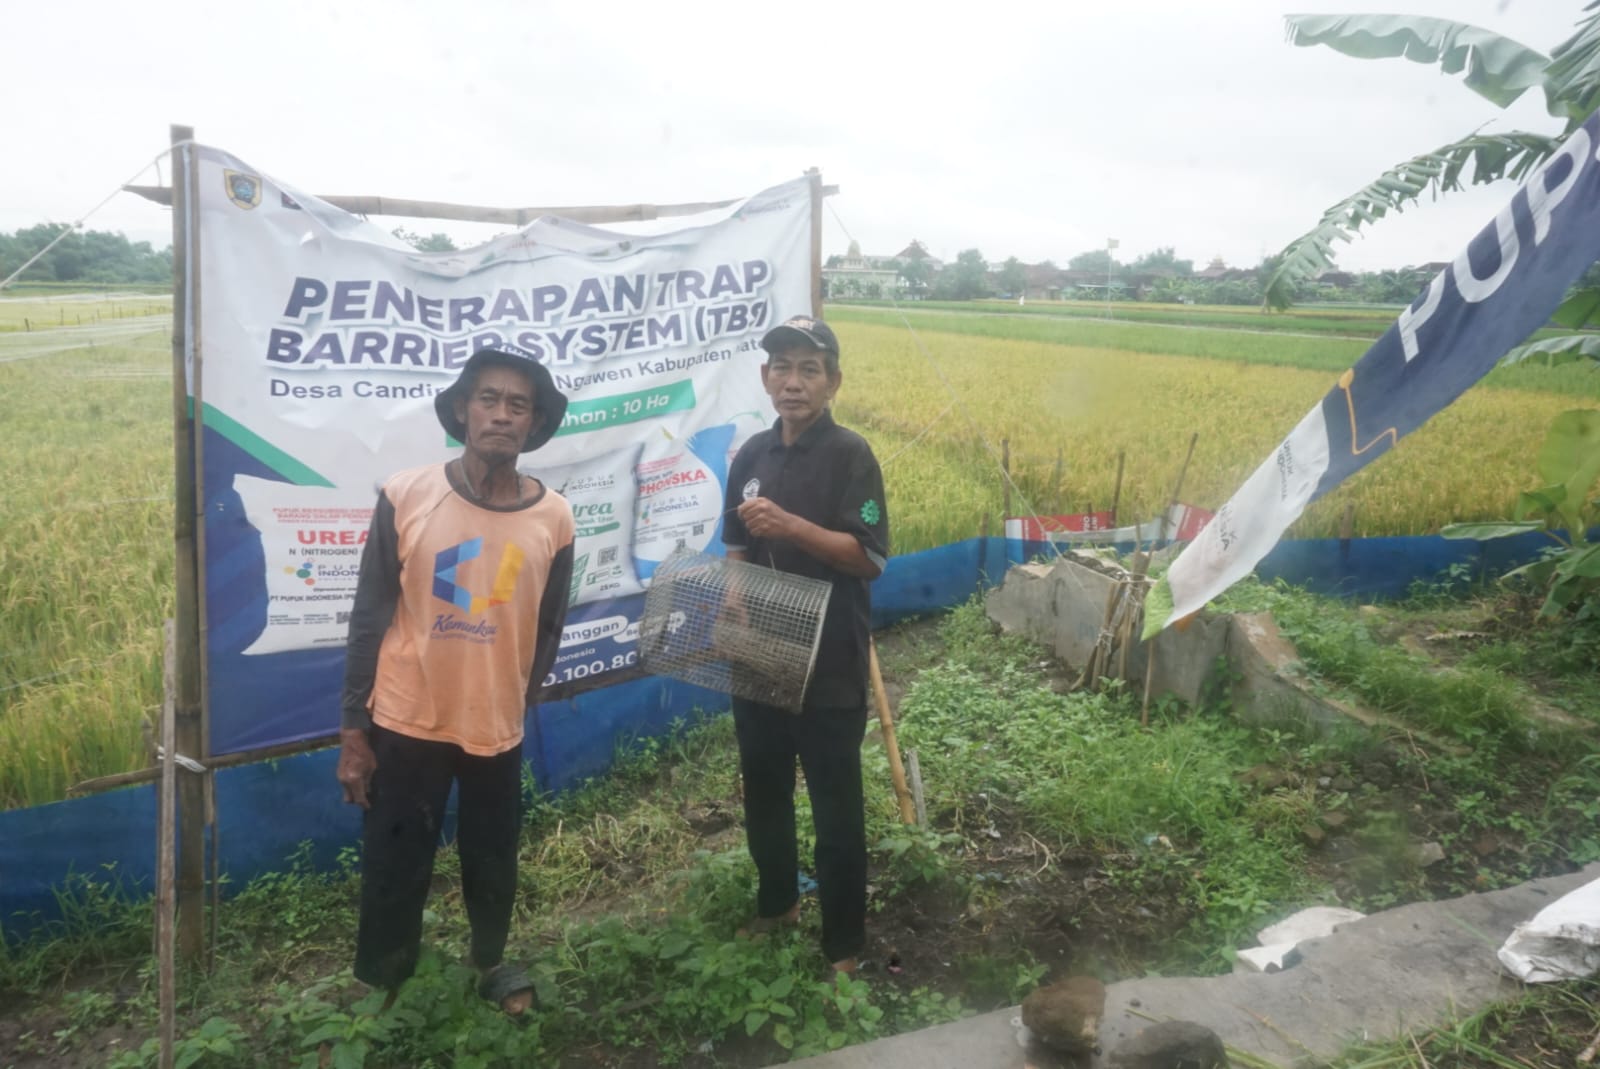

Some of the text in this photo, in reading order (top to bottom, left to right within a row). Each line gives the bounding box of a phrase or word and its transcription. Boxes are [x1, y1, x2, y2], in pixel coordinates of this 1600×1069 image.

[1399, 126, 1600, 362] PUP
[283, 259, 768, 332] PENERAPAN TRAP
[266, 327, 504, 370] BARRIER
[517, 313, 682, 361] SYSTEM
[270, 379, 342, 399] Desa
[555, 367, 633, 391] Ngawen
[638, 349, 732, 376] Kabupaten
[623, 398, 642, 415] 10
[646, 394, 670, 411] Ha
[297, 530, 368, 545] UREA
[562, 621, 620, 642] anggan
